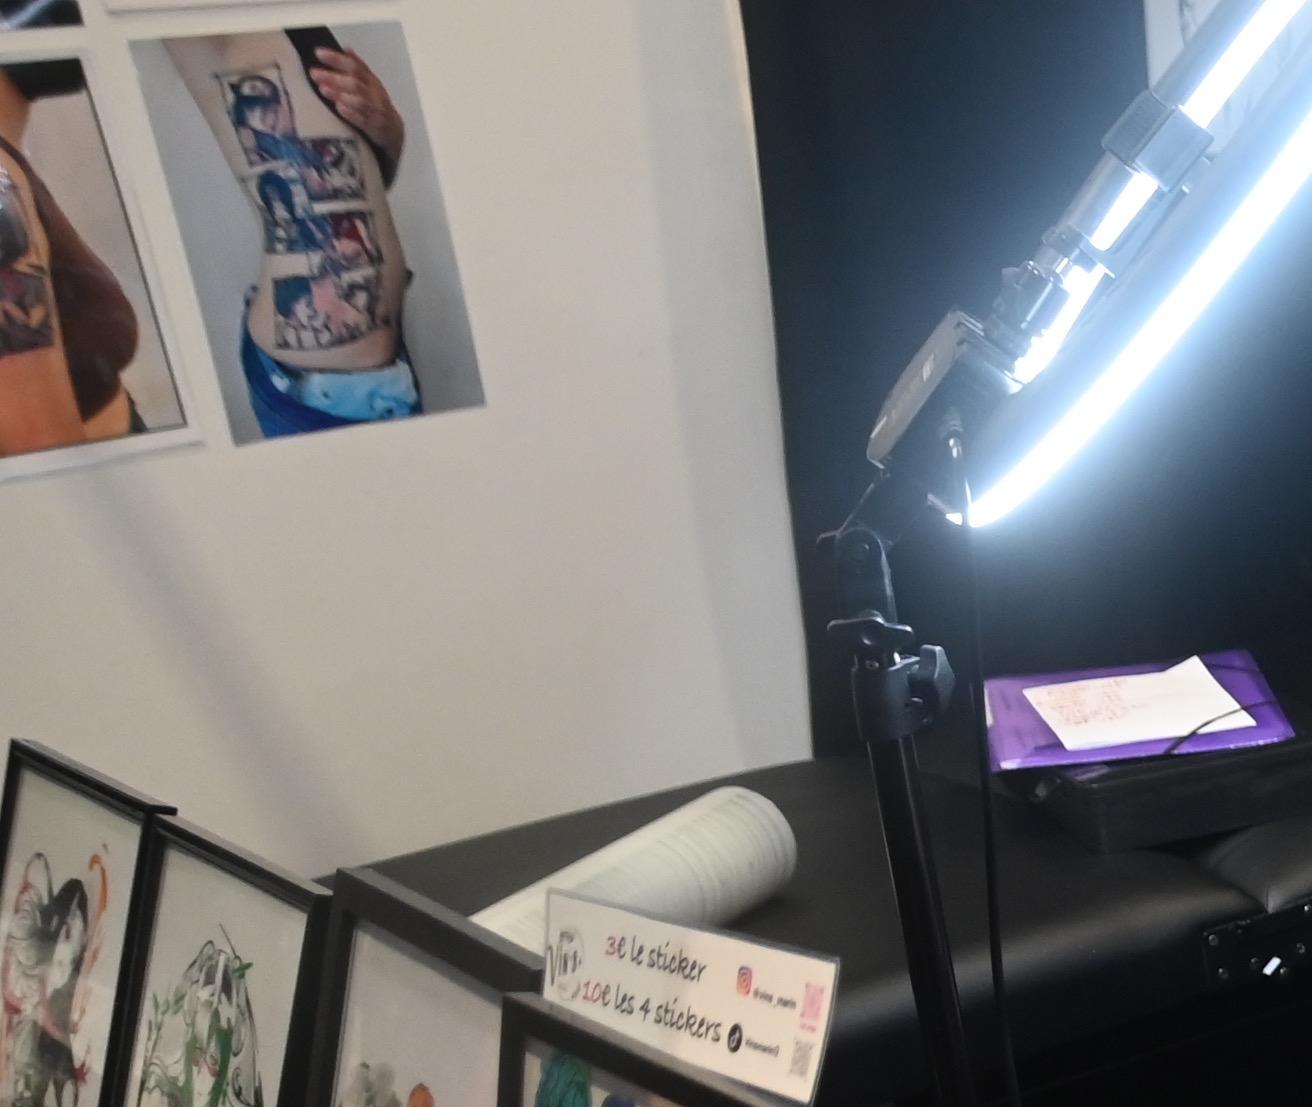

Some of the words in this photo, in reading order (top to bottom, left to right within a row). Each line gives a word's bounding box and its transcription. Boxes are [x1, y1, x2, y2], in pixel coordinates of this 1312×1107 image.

[604, 935, 627, 960] 3€
[631, 936, 645, 966] le
[646, 940, 708, 983] sticker
[582, 979, 612, 1007] 10€
[615, 983, 636, 1016] les
[639, 997, 651, 1022] 4
[653, 996, 722, 1043] stickers
